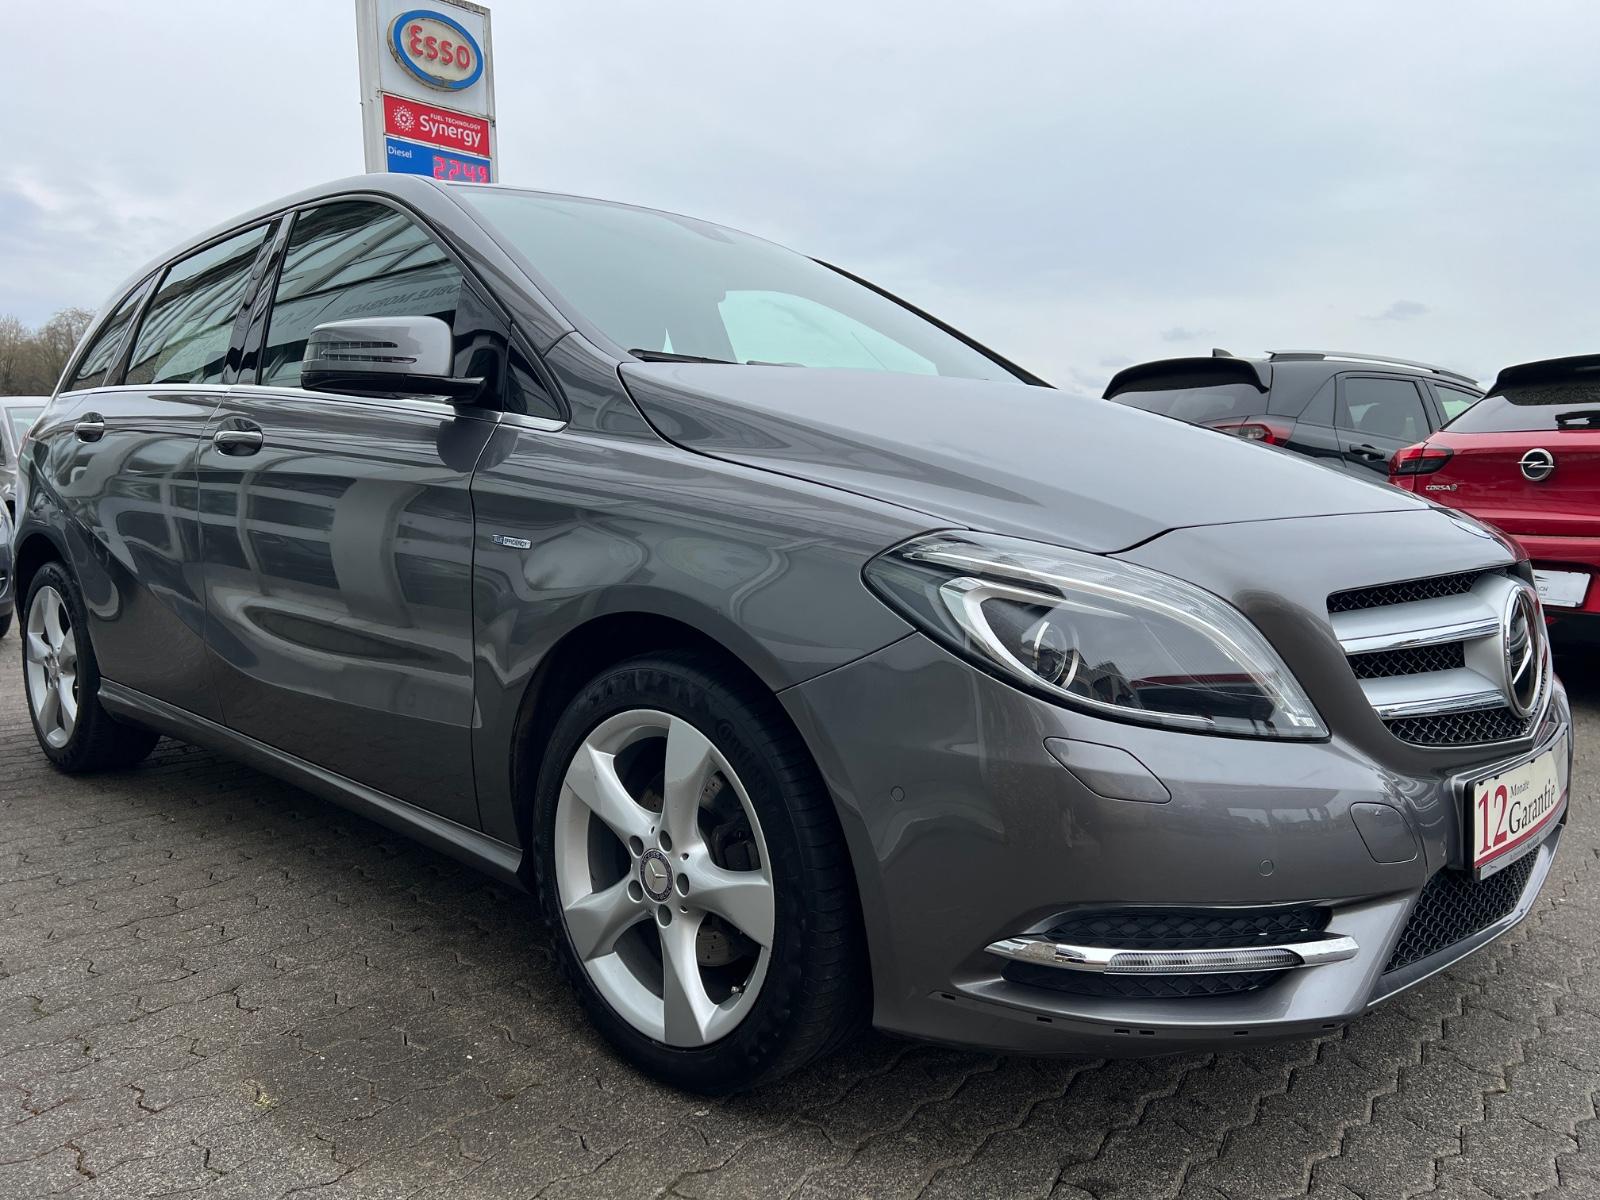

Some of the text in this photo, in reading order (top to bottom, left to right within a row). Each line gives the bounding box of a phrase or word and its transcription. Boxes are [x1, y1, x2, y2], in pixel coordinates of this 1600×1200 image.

[420, 115, 481, 147] Synergy
[430, 113, 481, 131] FUEL TECHNOLOGY
[388, 146, 412, 159] Diesel
[1510, 780, 1530, 798] Monate
[1508, 778, 1556, 835] Garantie
[1478, 785, 1508, 855] 12
